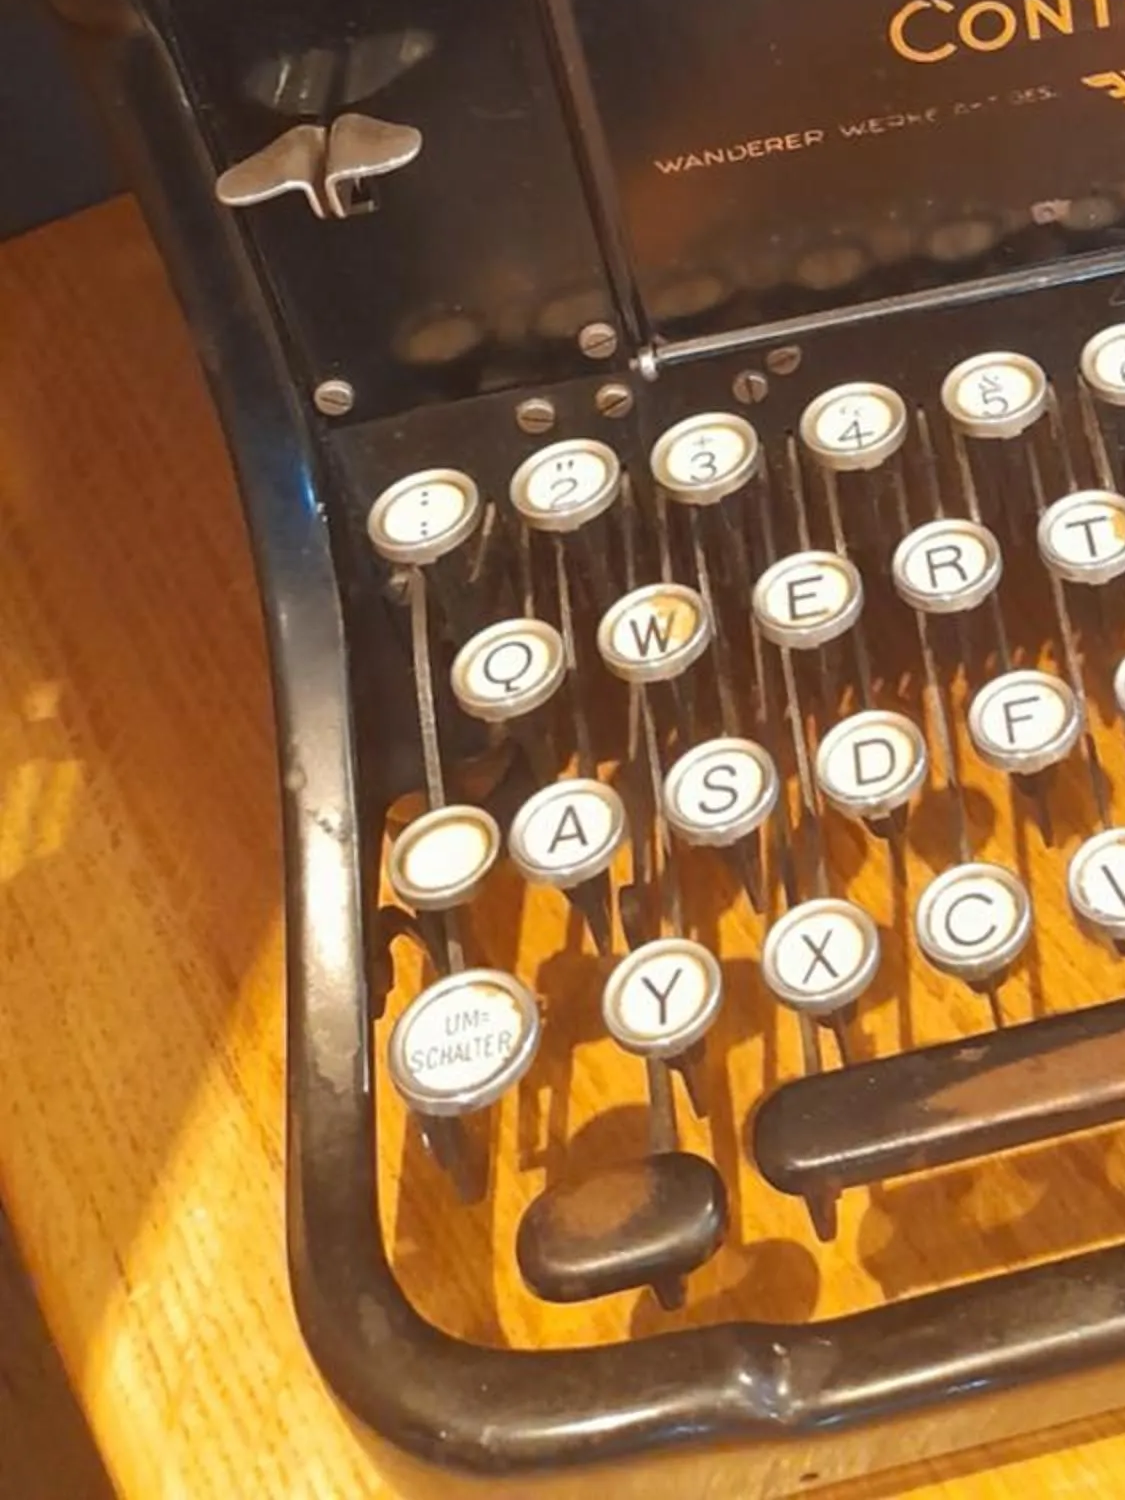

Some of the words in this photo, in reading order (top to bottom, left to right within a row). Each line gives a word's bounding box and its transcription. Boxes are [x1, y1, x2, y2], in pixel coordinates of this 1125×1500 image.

[655, 128, 823, 176] WANDERER
[981, 388, 1010, 420] 5
[838, 420, 874, 450] 4
[690, 451, 717, 484] 3
[550, 477, 579, 509] 2
[1065, 515, 1108, 558] T
[925, 544, 968, 589] R
[786, 574, 830, 621] E
[629, 610, 676, 657] W
[484, 641, 533, 692] Q
[1002, 696, 1041, 743] F
[852, 737, 896, 786] D
[698, 763, 739, 815] S
[547, 804, 589, 854] A
[944, 893, 996, 946] C
[801, 929, 839, 984] X
[641, 968, 682, 1025] Y
[409, 1029, 513, 1076] SCHALTER
